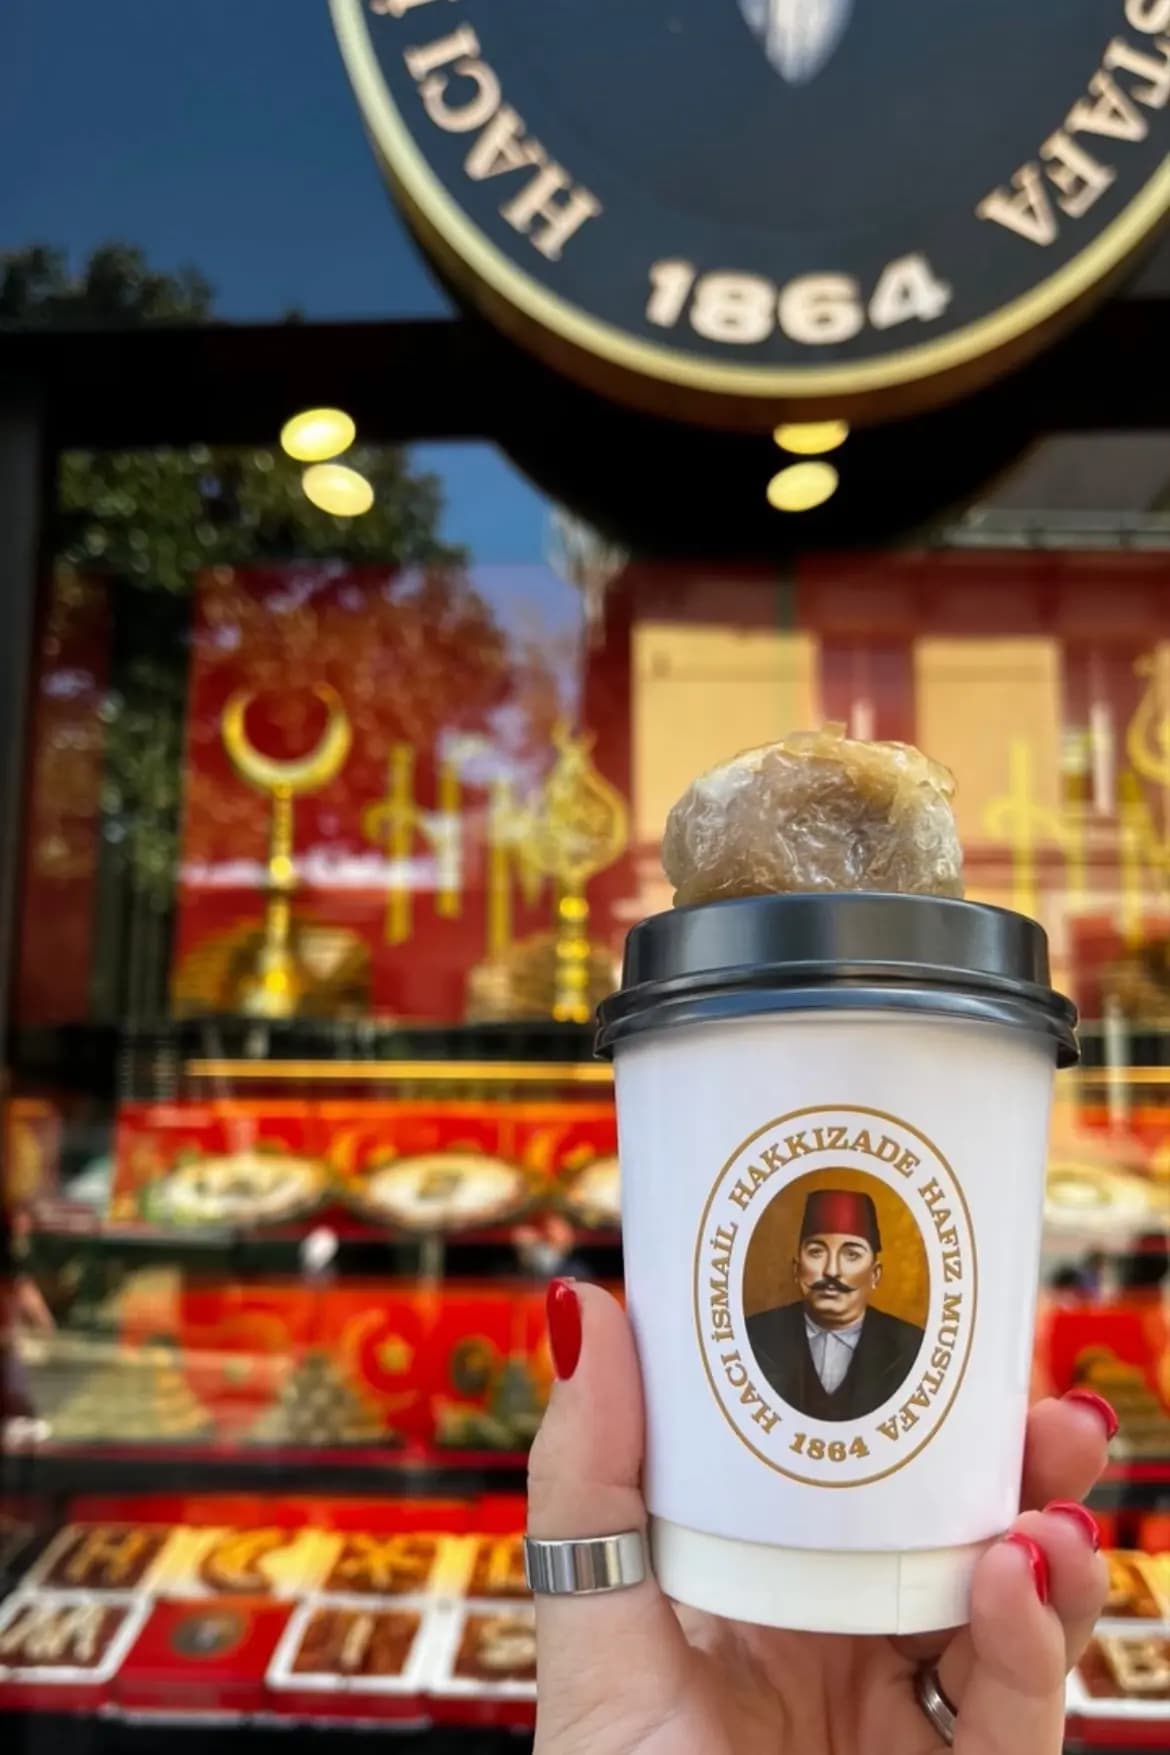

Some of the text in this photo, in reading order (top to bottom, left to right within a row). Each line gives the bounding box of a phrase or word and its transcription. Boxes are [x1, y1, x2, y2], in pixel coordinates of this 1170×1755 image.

[404, 23, 602, 260] HACI
[648, 254, 948, 344] 1864
[710, 1126, 962, 1442] HACI İSMAİL HAKKIZADE HAFIZ MUSTAFA
[789, 1432, 870, 1462] 1864
